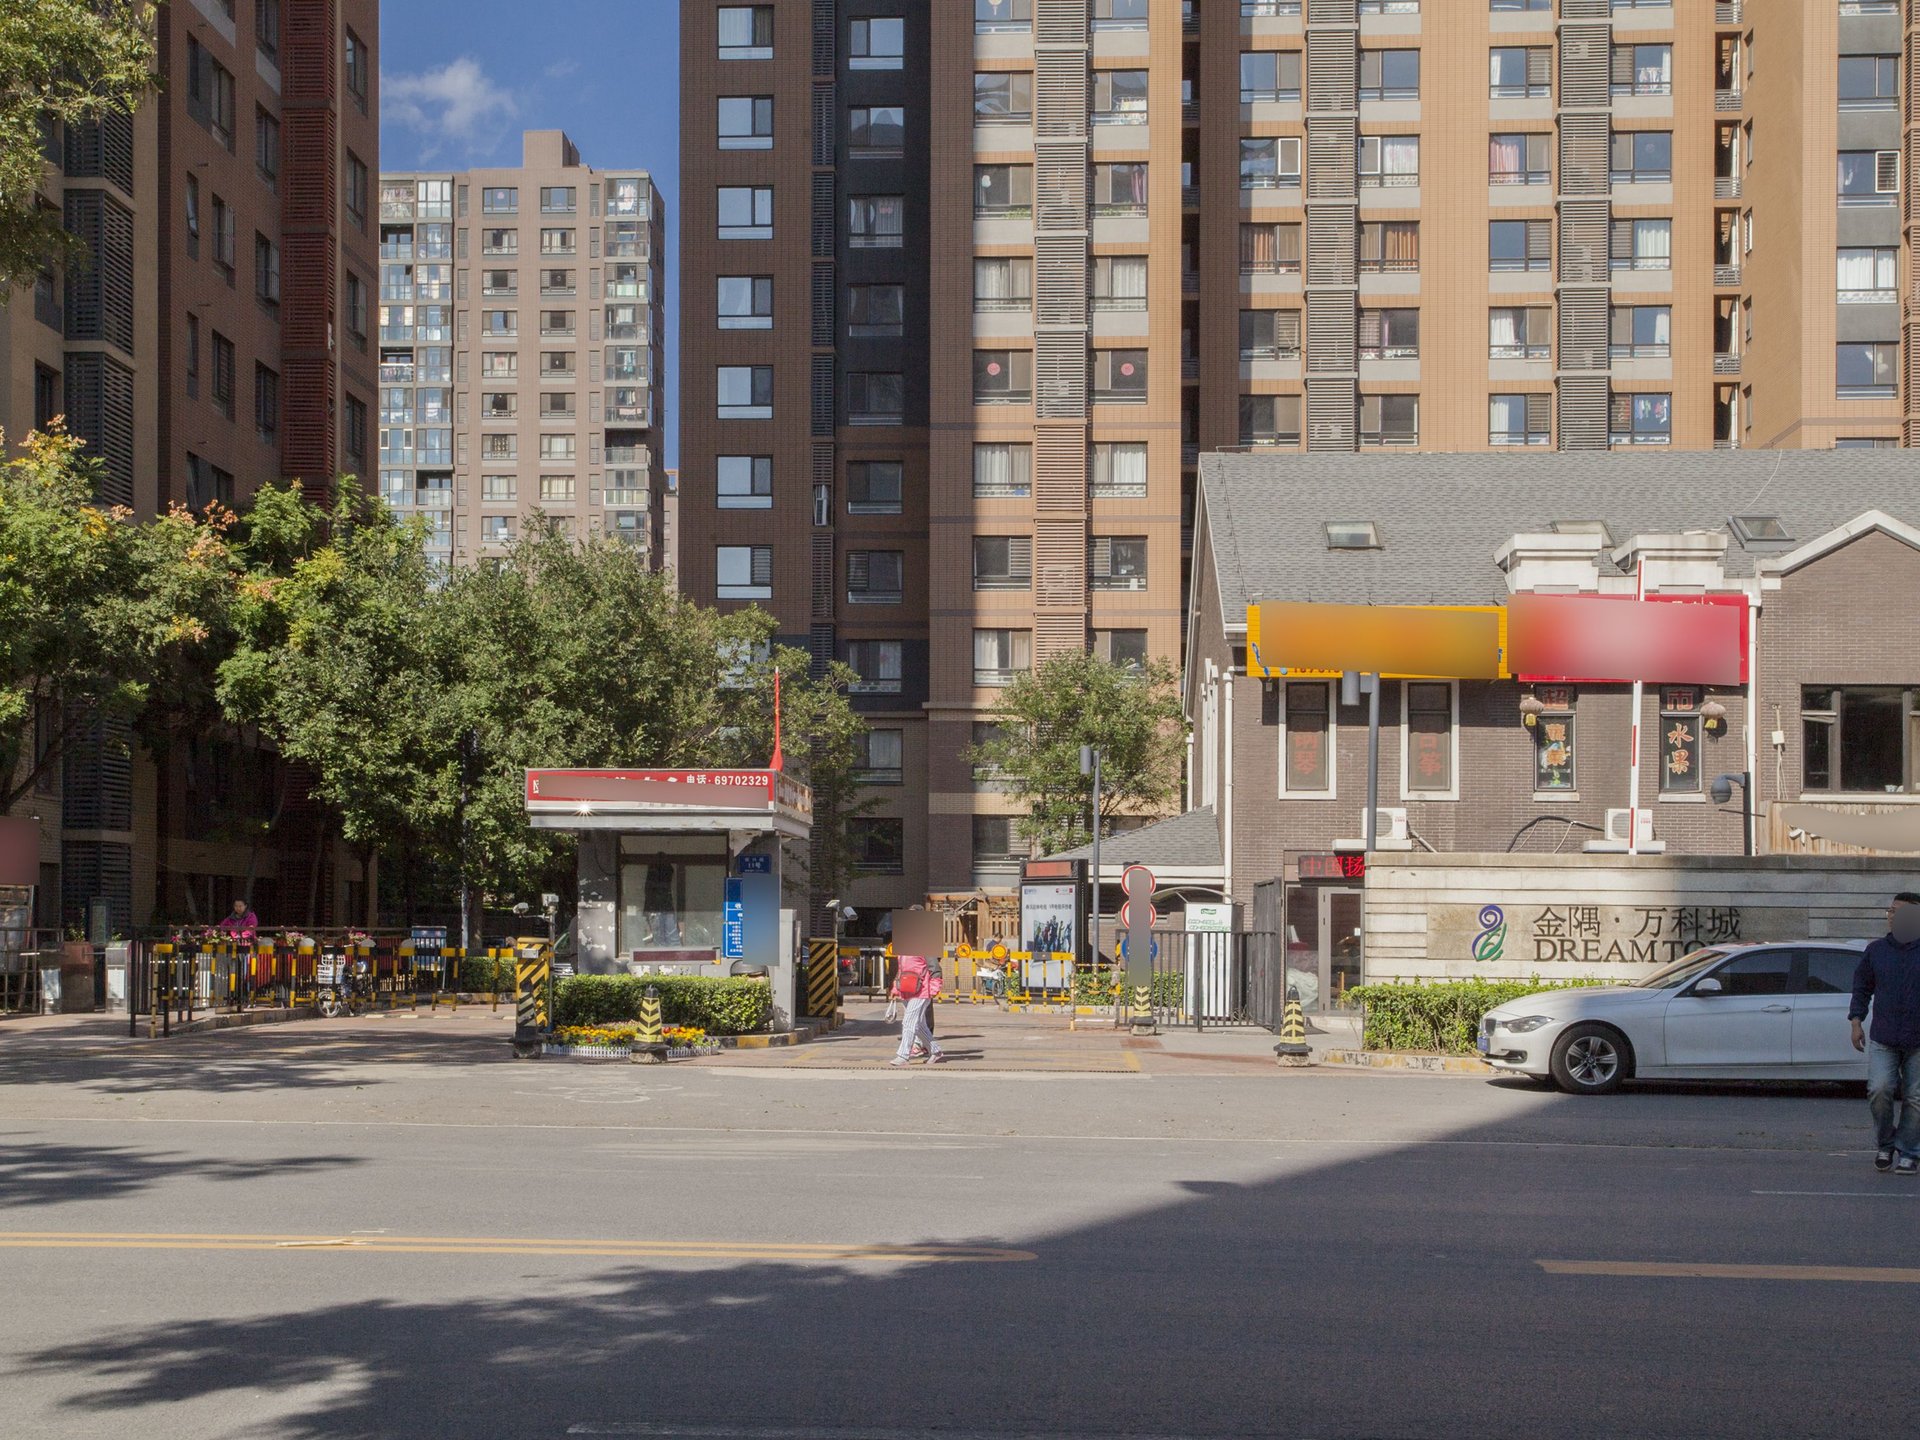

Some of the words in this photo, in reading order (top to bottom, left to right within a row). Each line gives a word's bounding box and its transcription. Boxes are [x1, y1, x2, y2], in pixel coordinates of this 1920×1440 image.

[1543, 688, 1569, 710] 超
[1667, 689, 1694, 711] 市
[1667, 722, 1694, 775] 水果
